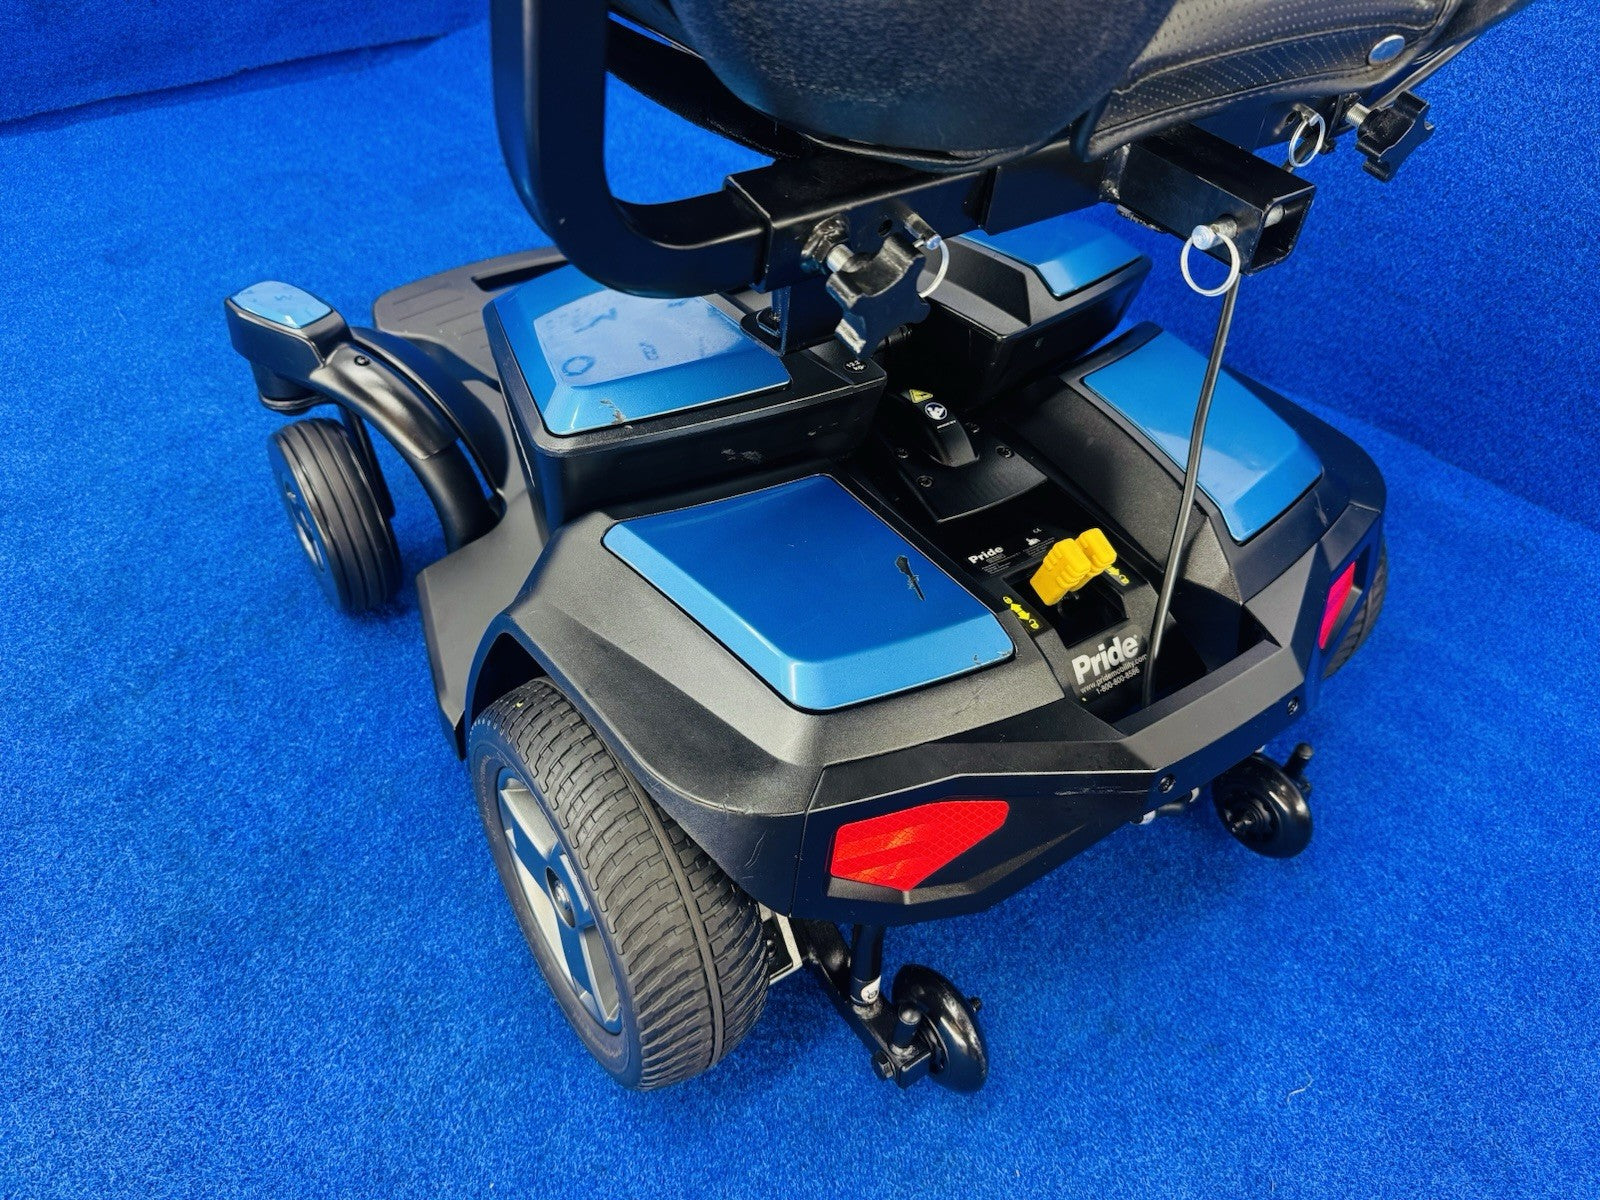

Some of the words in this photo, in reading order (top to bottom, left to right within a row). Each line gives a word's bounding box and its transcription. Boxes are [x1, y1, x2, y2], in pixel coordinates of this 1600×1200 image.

[967, 546, 1004, 564] Pride
[1071, 636, 1138, 685] Pride
[1080, 654, 1147, 694] www.pridemobility.com
